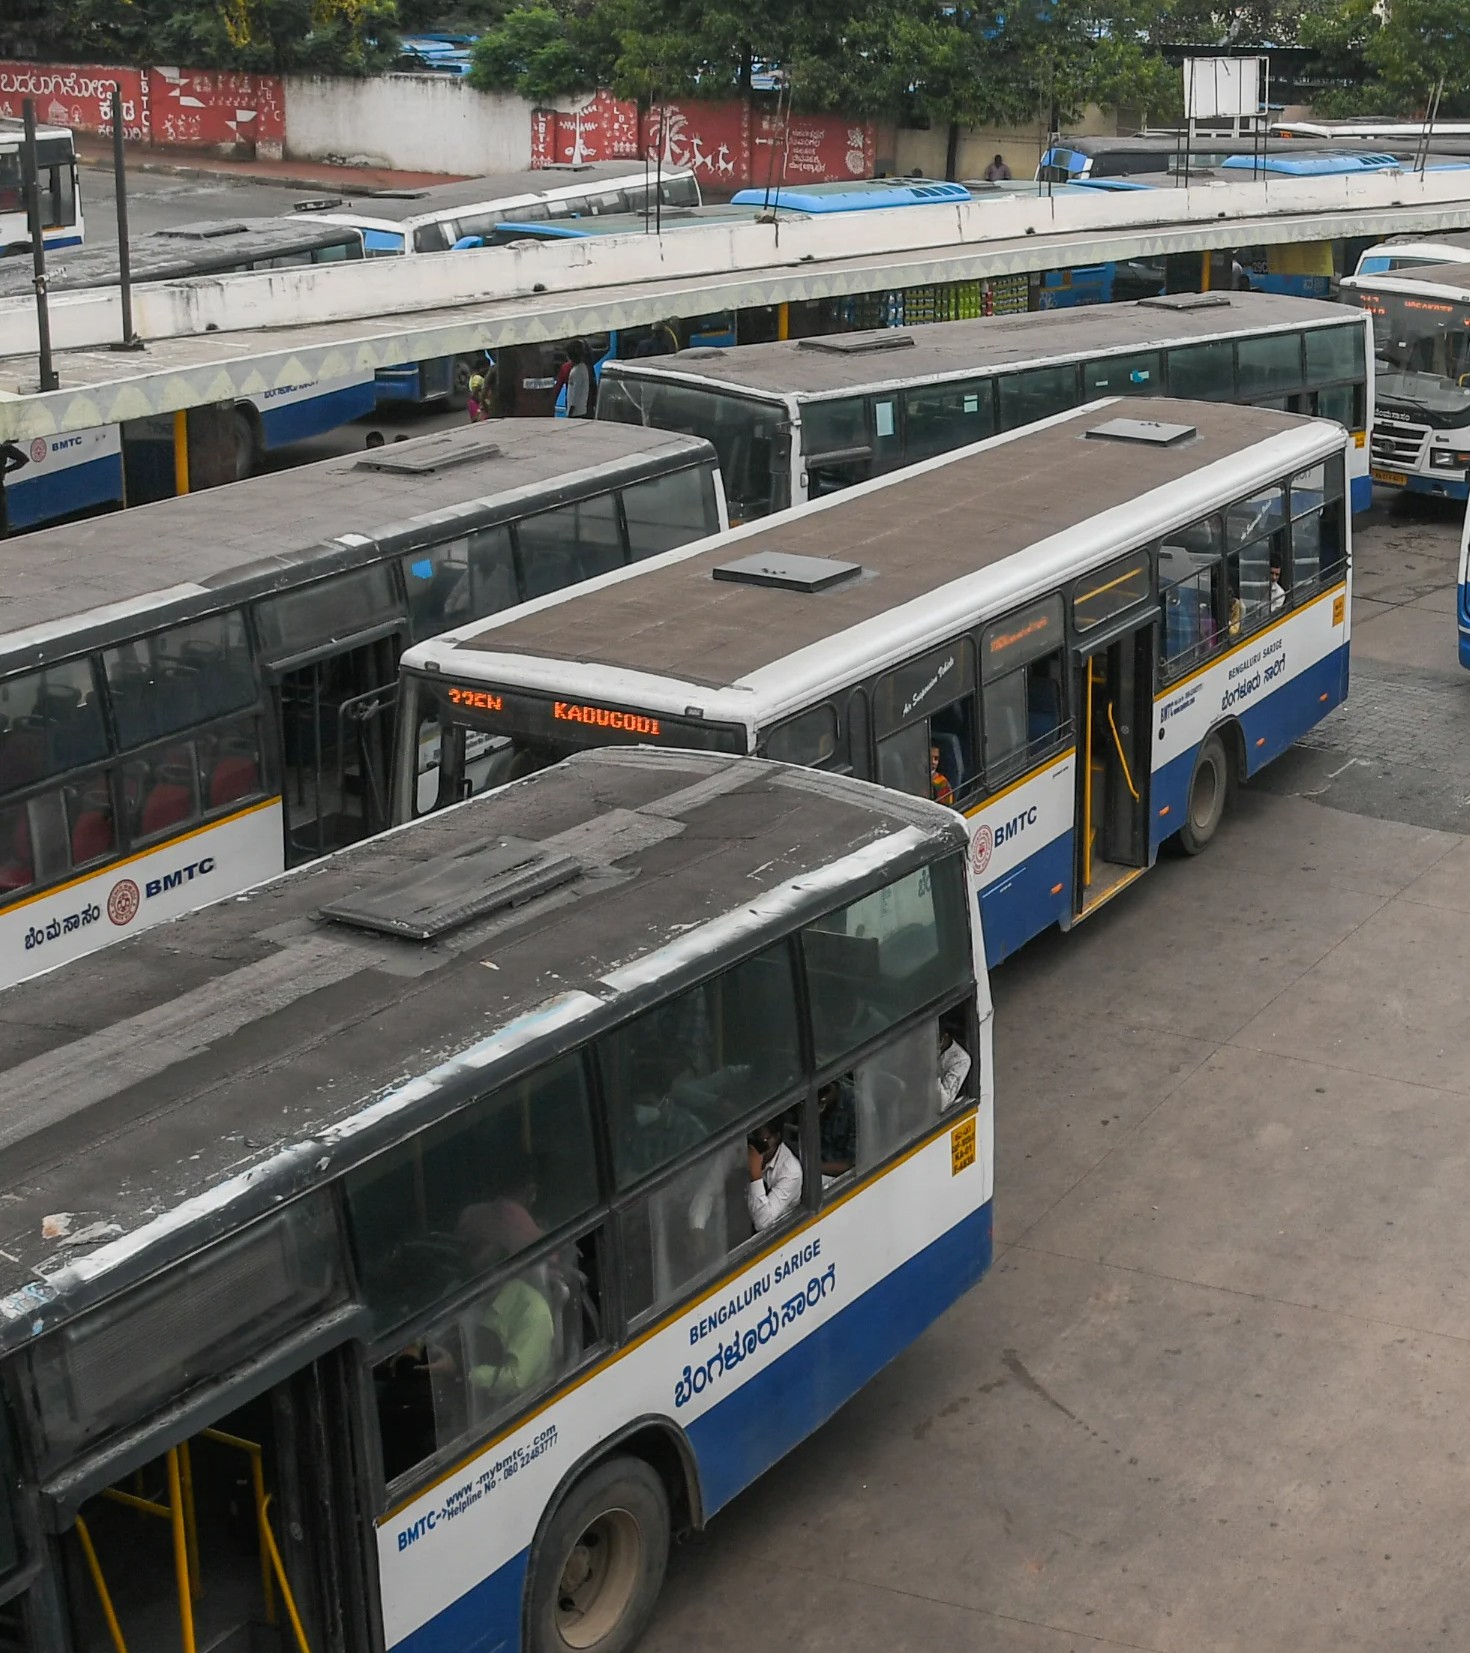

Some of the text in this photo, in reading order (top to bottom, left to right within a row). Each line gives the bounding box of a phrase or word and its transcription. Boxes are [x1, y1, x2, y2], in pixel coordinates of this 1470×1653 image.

[51, 436, 83, 452] BMTC
[1228, 638, 1283, 680] BENGALURU SARIGE
[554, 701, 660, 735] KADUGODI
[994, 805, 1038, 848] BMTC
[145, 857, 215, 899] BMTC
[690, 1238, 821, 1346] BENGALURU SARIGE
[674, 1306, 780, 1408] ಬೆಂಗಳೂರು
[446, 1491, 482, 1521] Helpline
[484, 1479, 496, 1494] No
[503, 1461, 518, 1480] 080
